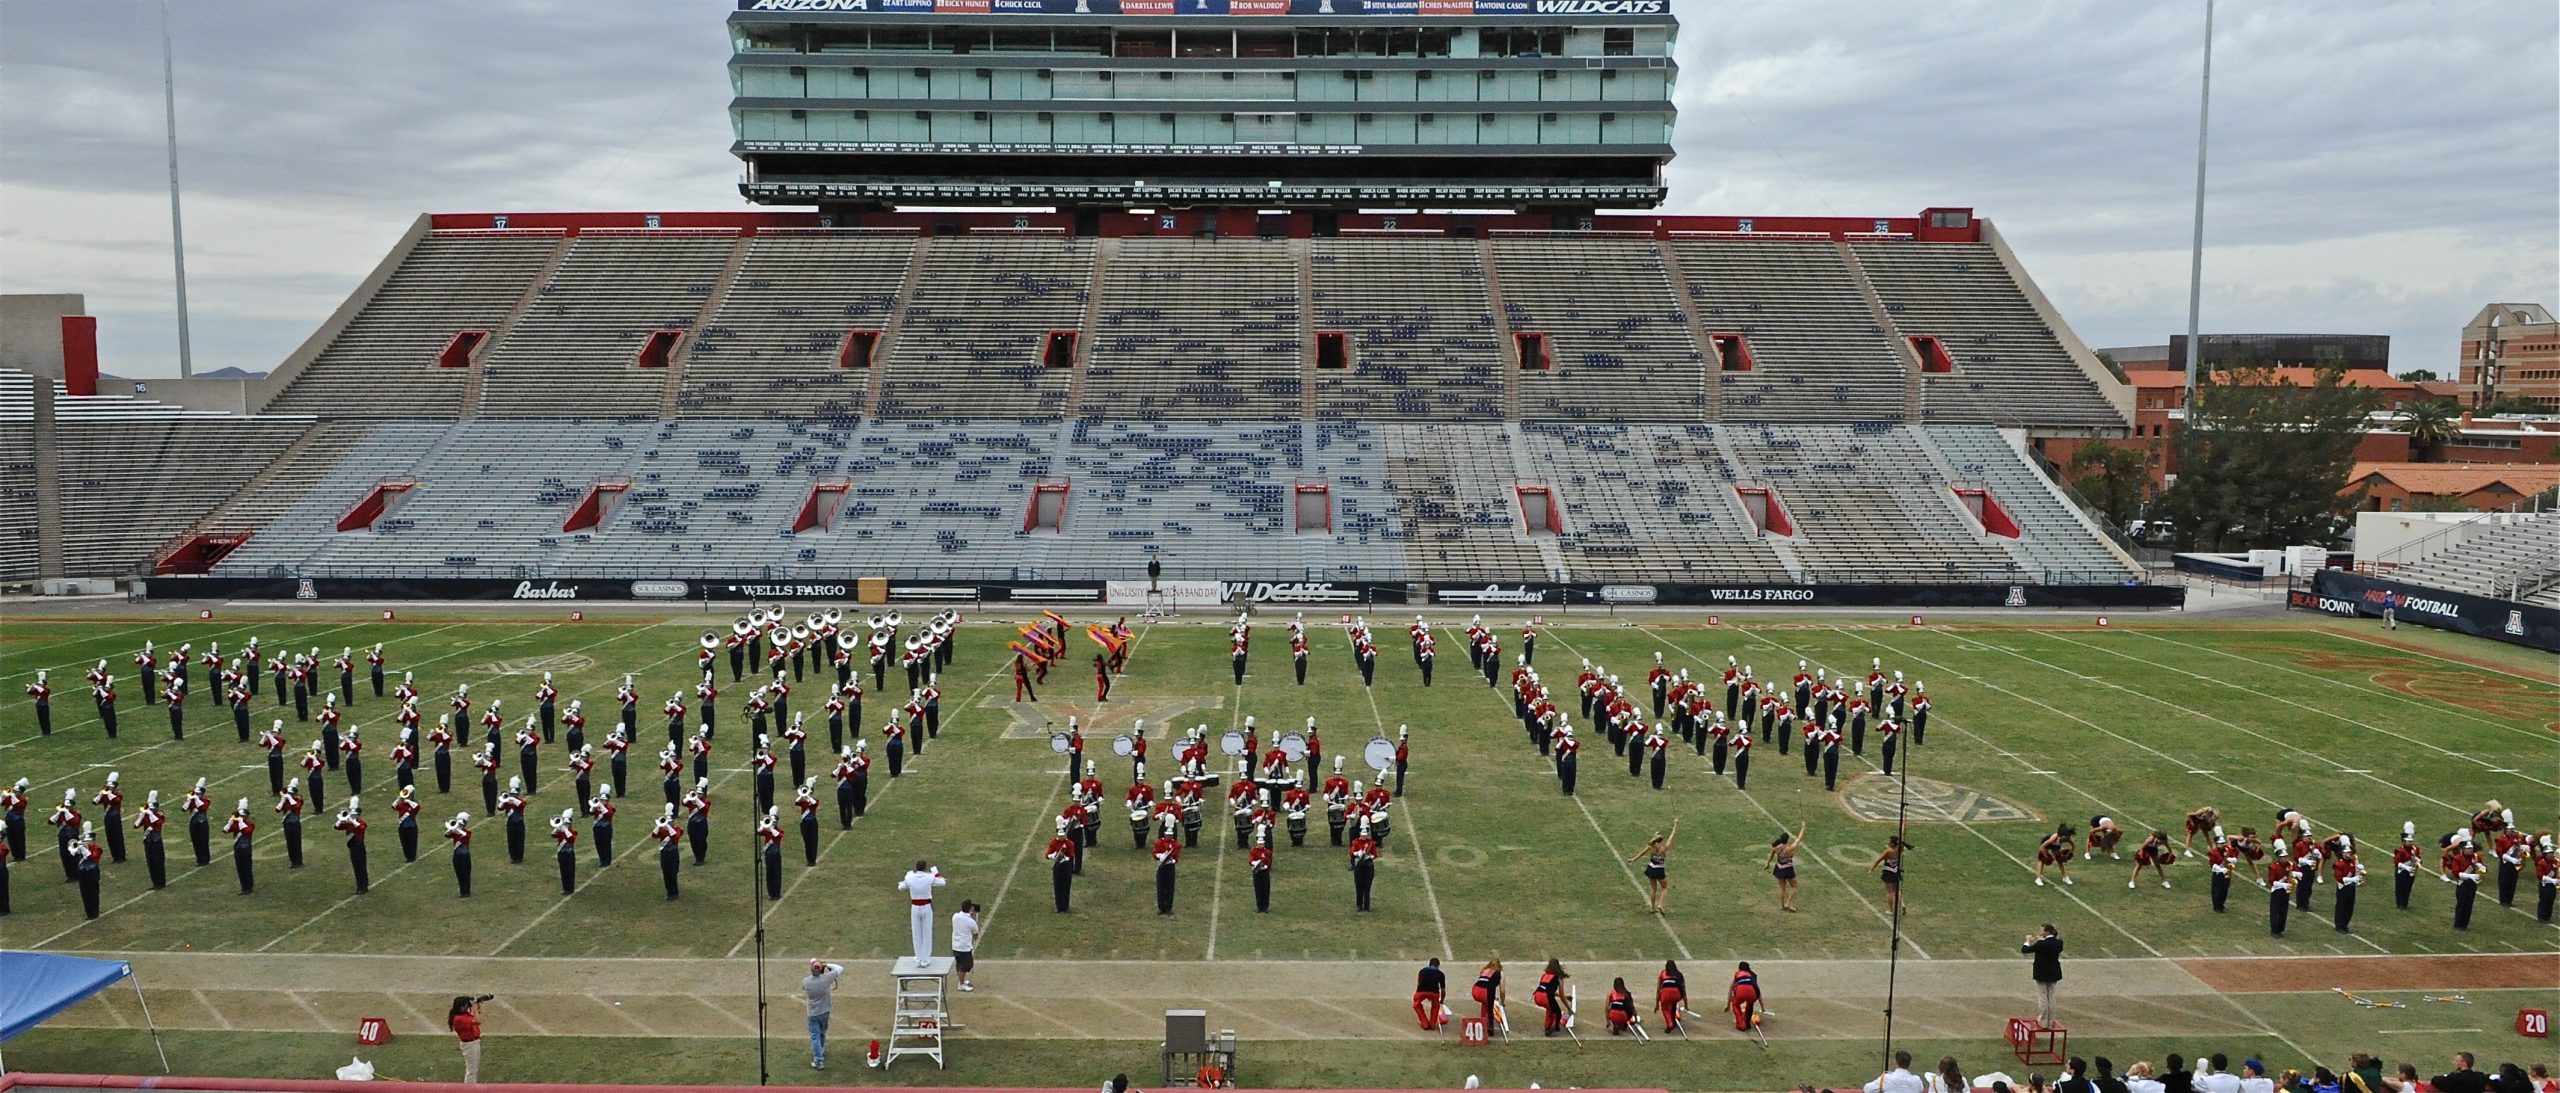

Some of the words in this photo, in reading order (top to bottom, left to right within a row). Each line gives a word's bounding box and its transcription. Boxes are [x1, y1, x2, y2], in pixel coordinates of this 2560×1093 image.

[751, 0, 867, 10] ARIZONA
[1000, 0, 1021, 8] CHUCK
[1023, 0, 1041, 8] CECIL
[1239, 1, 1252, 9] ROB
[1253, 1, 1284, 9] WALDROP
[1372, 1, 1386, 9] STEVE
[1480, 1, 1505, 9] ANTOINE
[1506, 1, 1528, 9] CASON
[1537, 0, 1663, 13] WILDCATS
[495, 220, 506, 229] 17
[647, 219, 659, 229] 18
[821, 219, 832, 229] 19
[1015, 219, 1028, 229] 20
[1162, 219, 1174, 229] 21
[1383, 220, 1396, 230] 22
[1580, 221, 1592, 231] 23
[1739, 223, 1752, 232] 24
[1875, 224, 1888, 234] 25
[136, 383, 146, 392] 16
[742, 585, 793, 596] WELLS
[796, 585, 846, 596] FARGO
[1109, 587, 1144, 598] UNIVERSITY
[1186, 587, 1203, 598] BAND
[1205, 587, 1218, 598] DAY
[1710, 589, 1761, 600] WELLS
[1764, 589, 1814, 600] FARGO
[2404, 596, 2459, 617] FOOTBALL
[2525, 1013, 2546, 1033] 20
[360, 1021, 379, 1041] 40
[1465, 1021, 1484, 1041] 40
